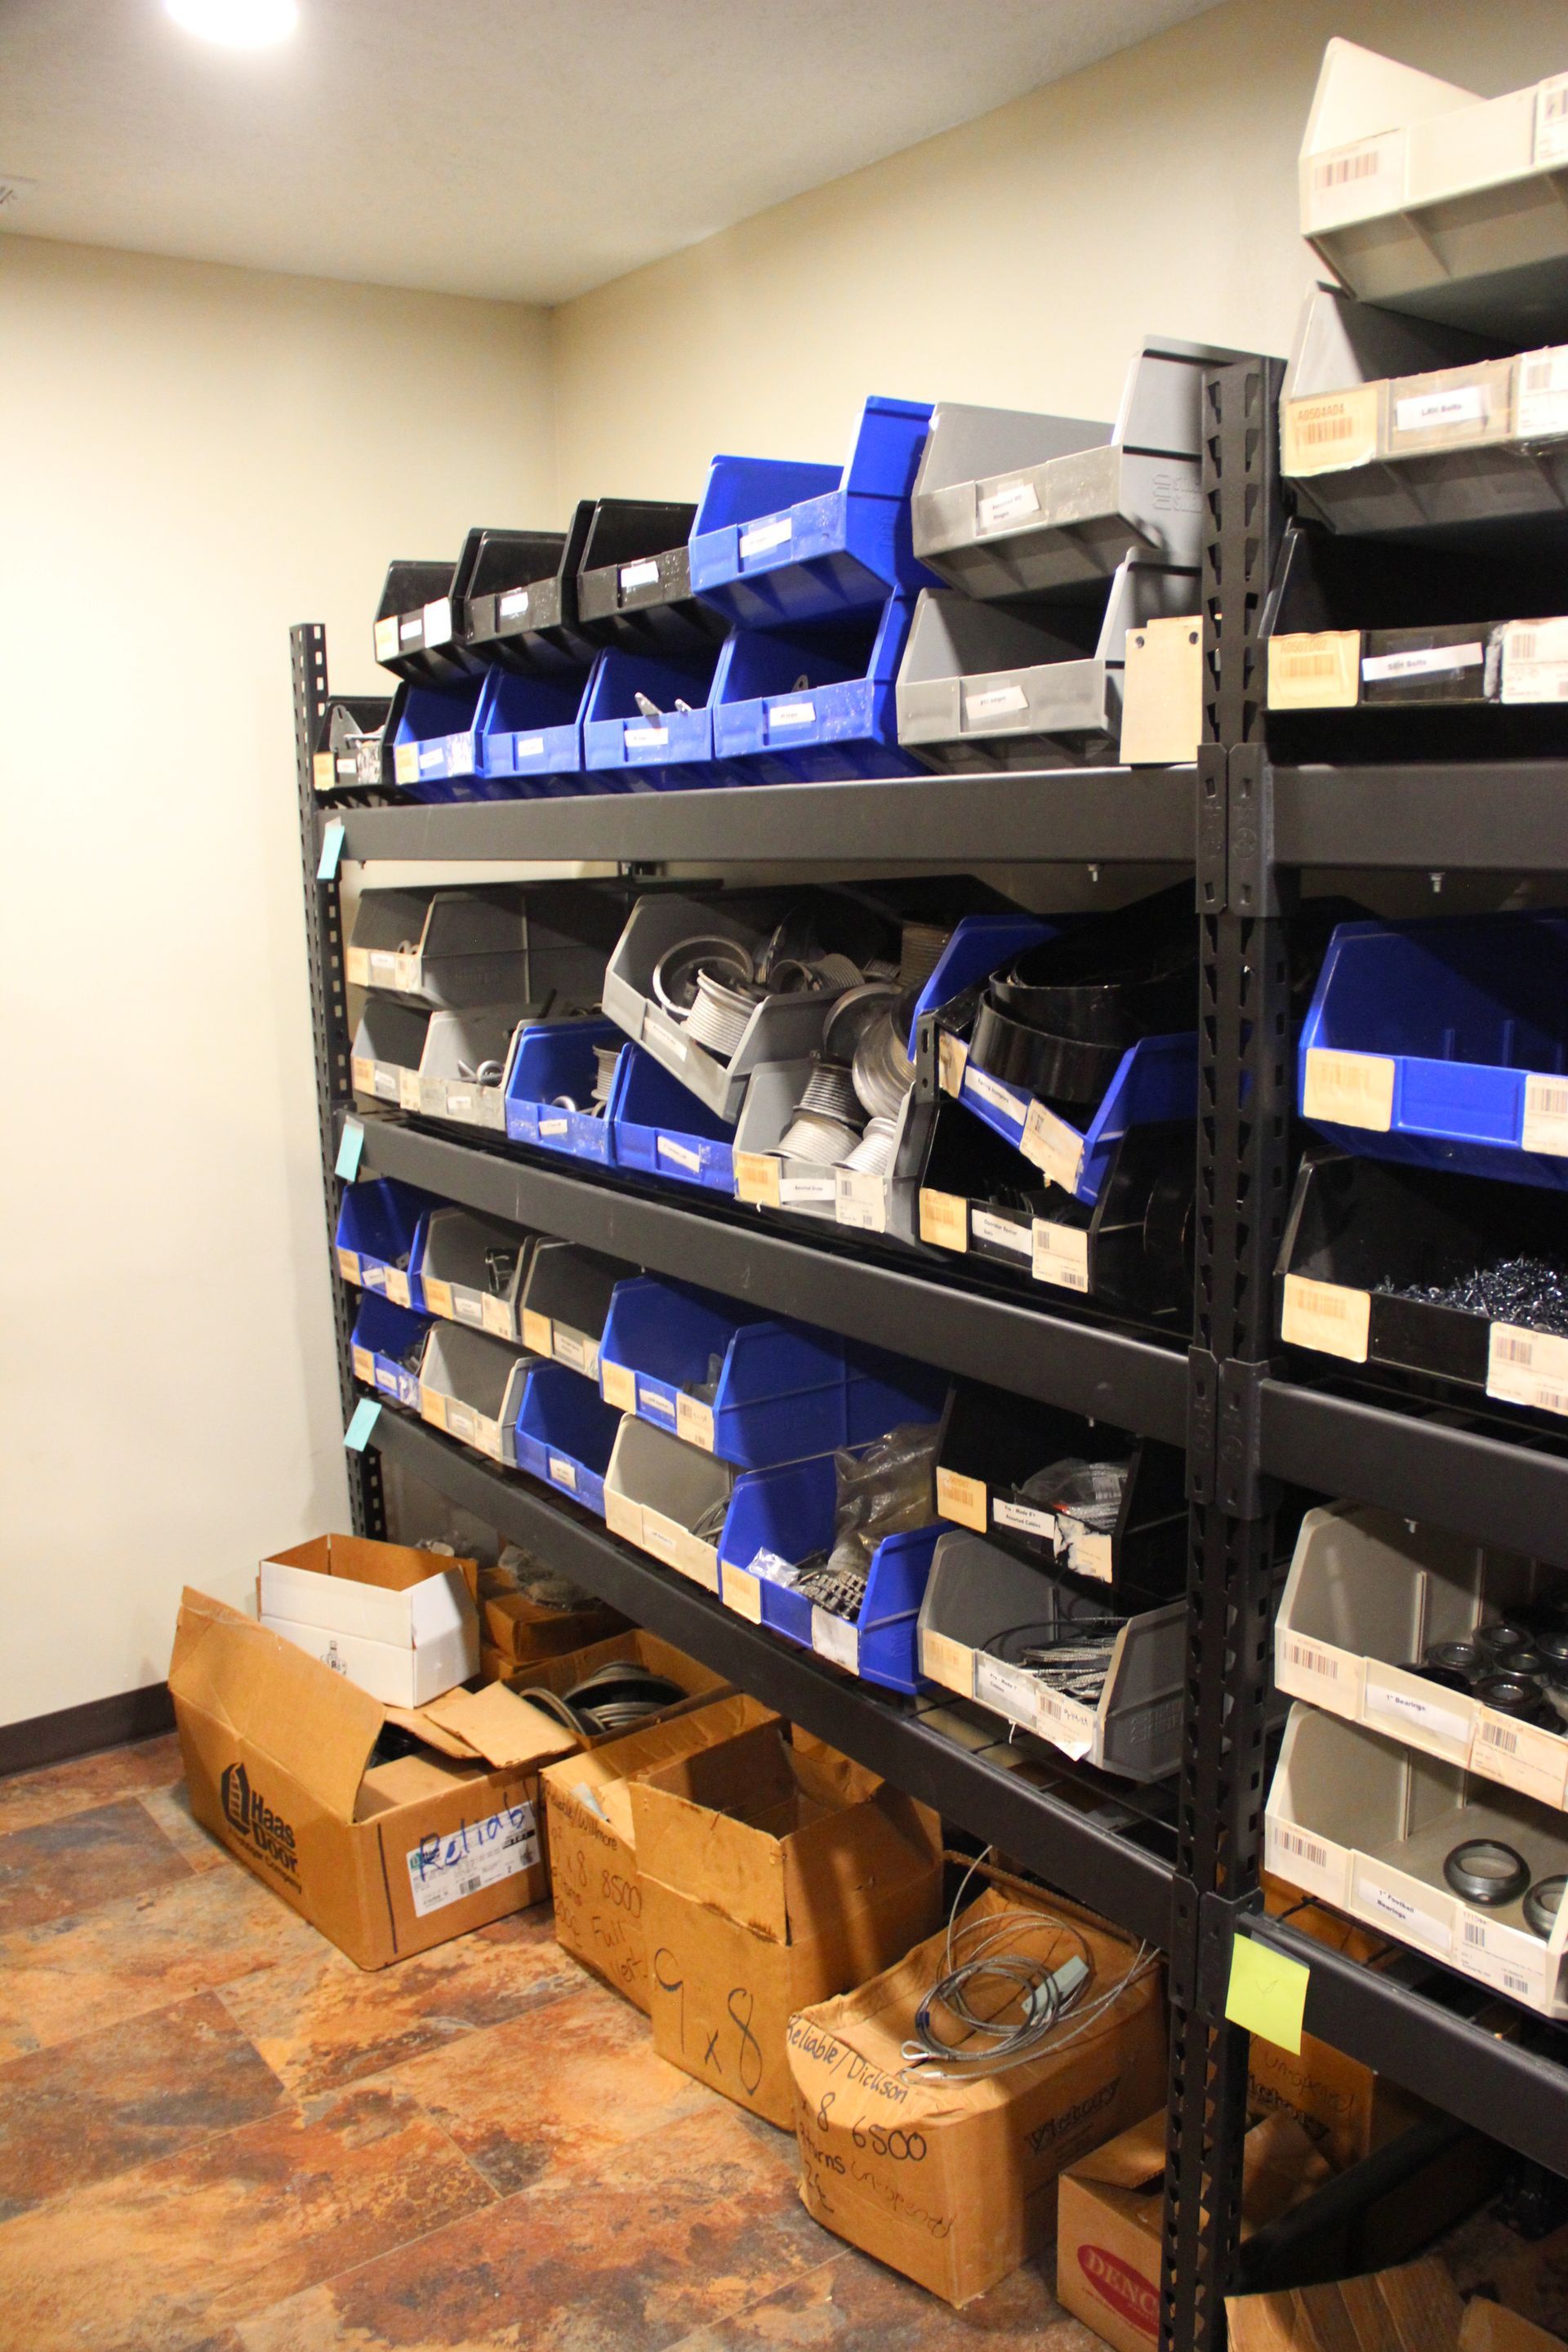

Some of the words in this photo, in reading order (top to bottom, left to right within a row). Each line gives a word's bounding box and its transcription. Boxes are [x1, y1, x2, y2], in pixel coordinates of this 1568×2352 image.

[1395, 1697, 1426, 1711] Bearings
[252, 1789, 296, 1848] Haas
[252, 1821, 298, 1873] Door
[1377, 1900, 1405, 1919] Bearings
[1388, 1894, 1414, 1913] Football
[704, 2029, 723, 2074] x
[727, 1987, 764, 2096] 8
[817, 2091, 836, 2132] 8
[851, 2114, 928, 2161] 6500
